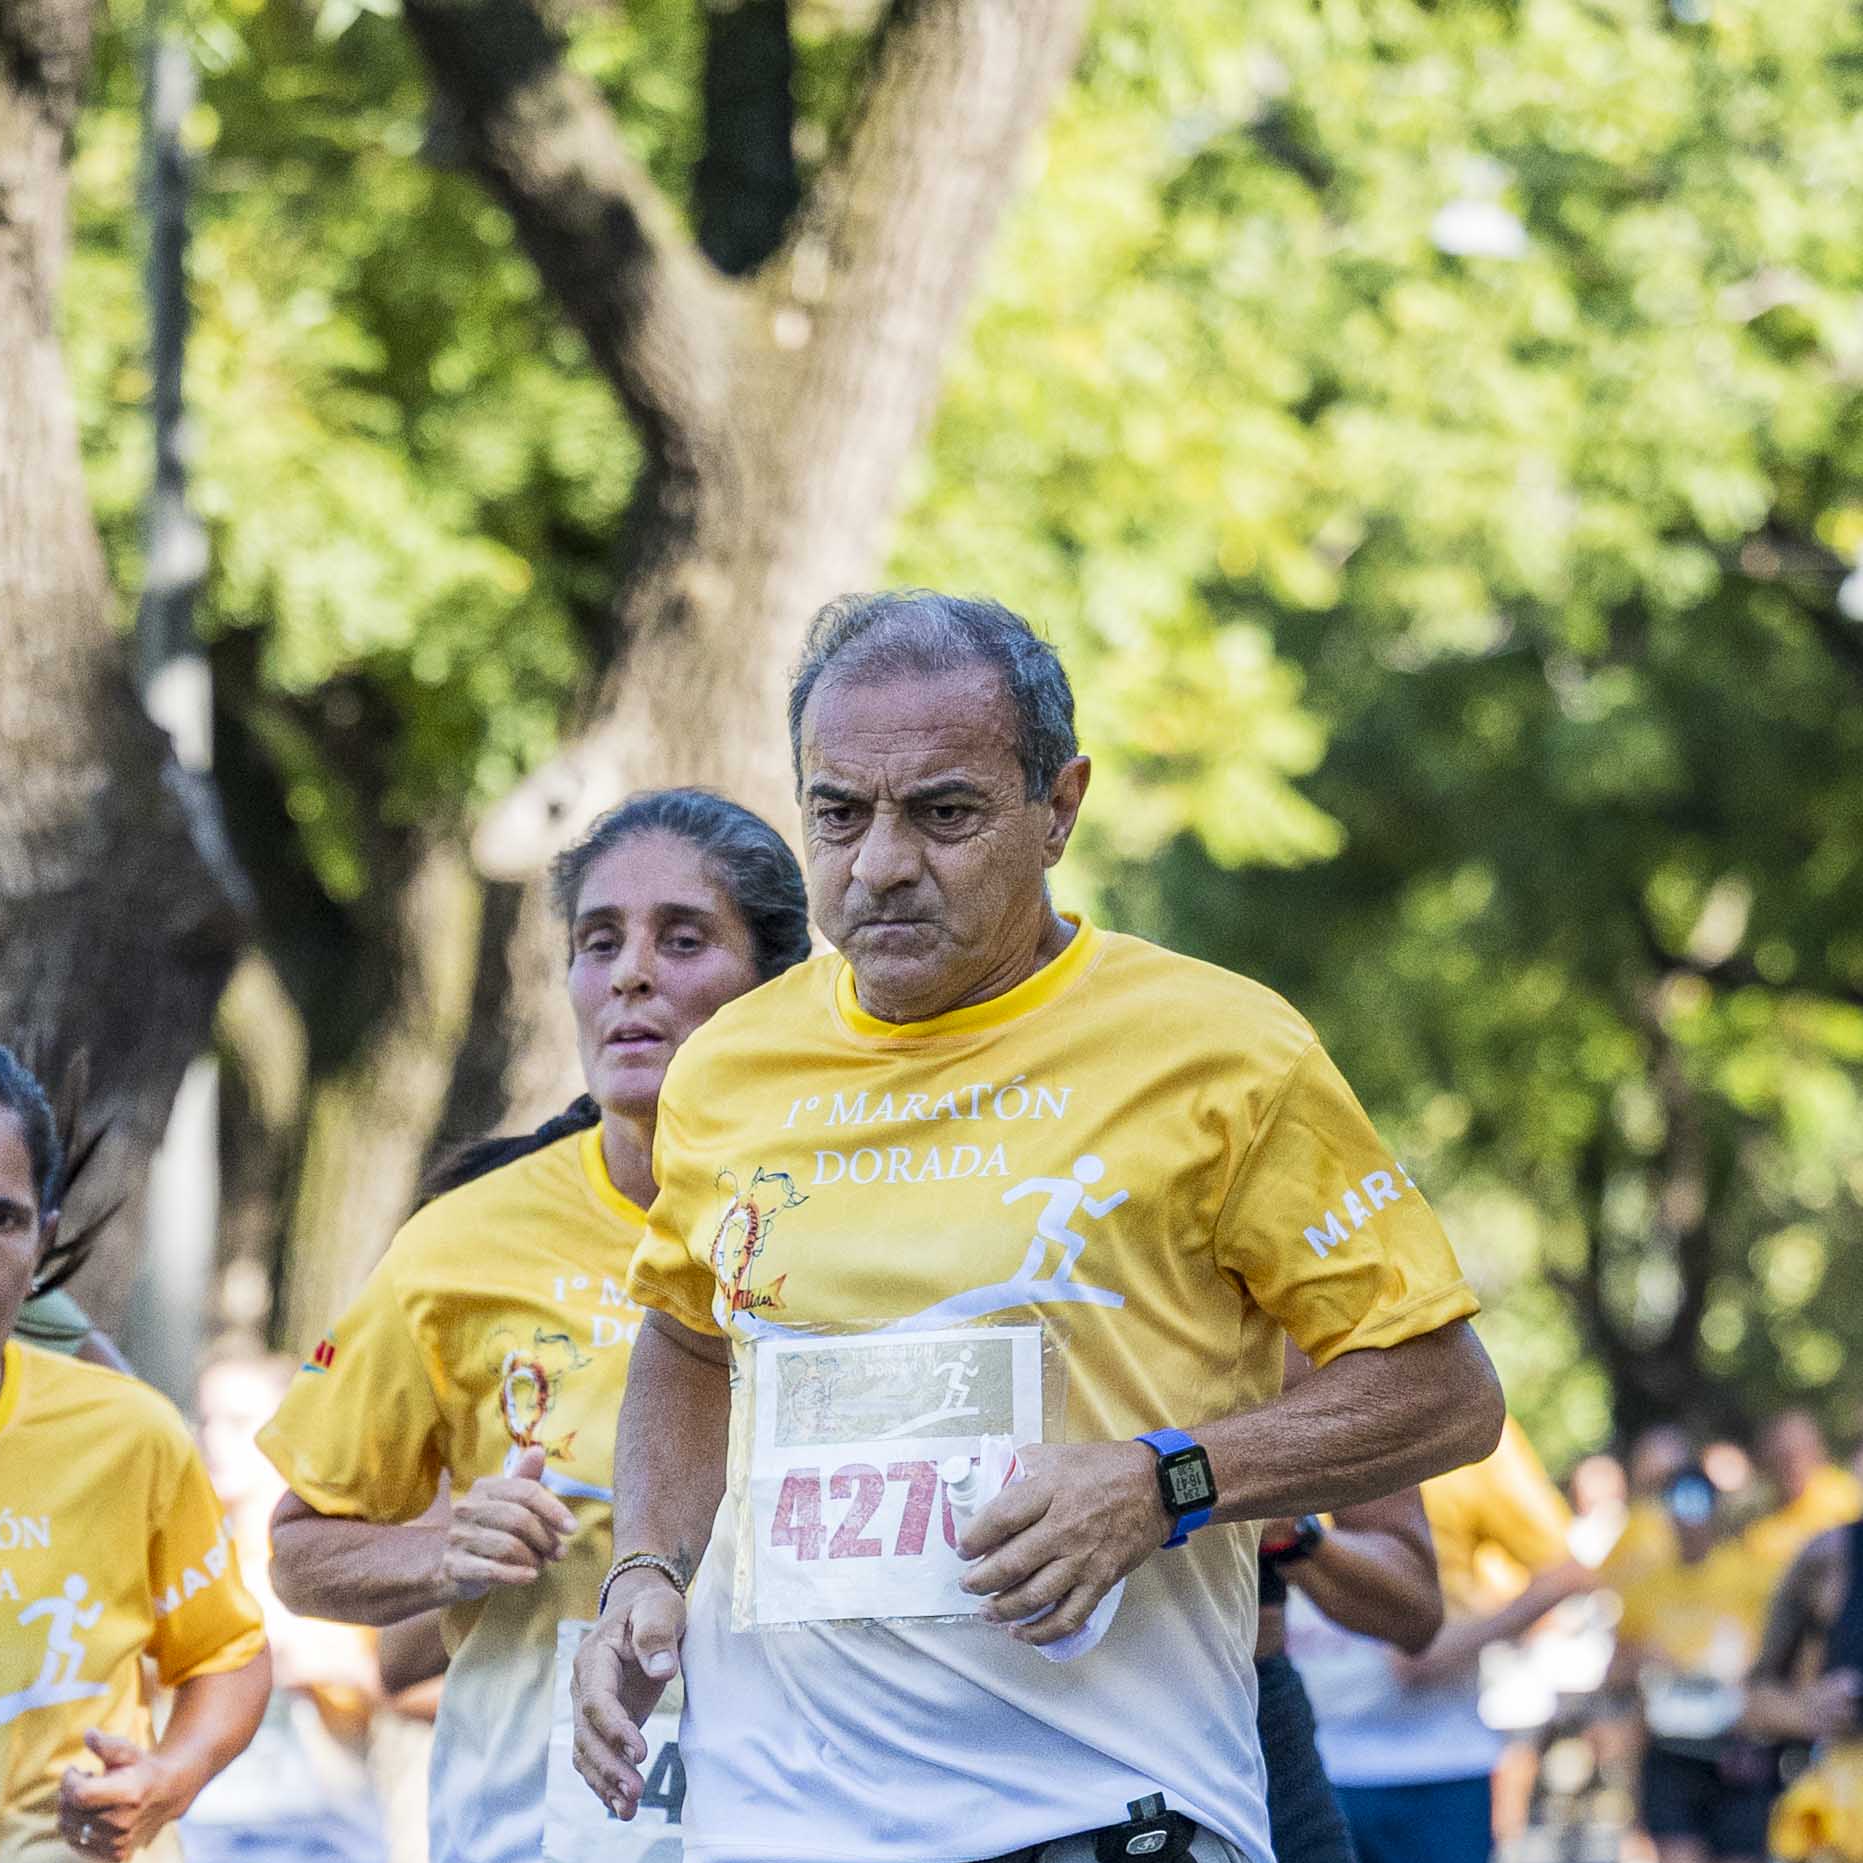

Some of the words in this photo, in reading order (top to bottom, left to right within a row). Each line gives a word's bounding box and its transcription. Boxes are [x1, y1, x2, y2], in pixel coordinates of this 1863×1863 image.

[824, 1074, 1072, 1127] MARATÓN
[811, 1143, 1011, 1184] DORADA
[154, 1515, 233, 1619] MAR
